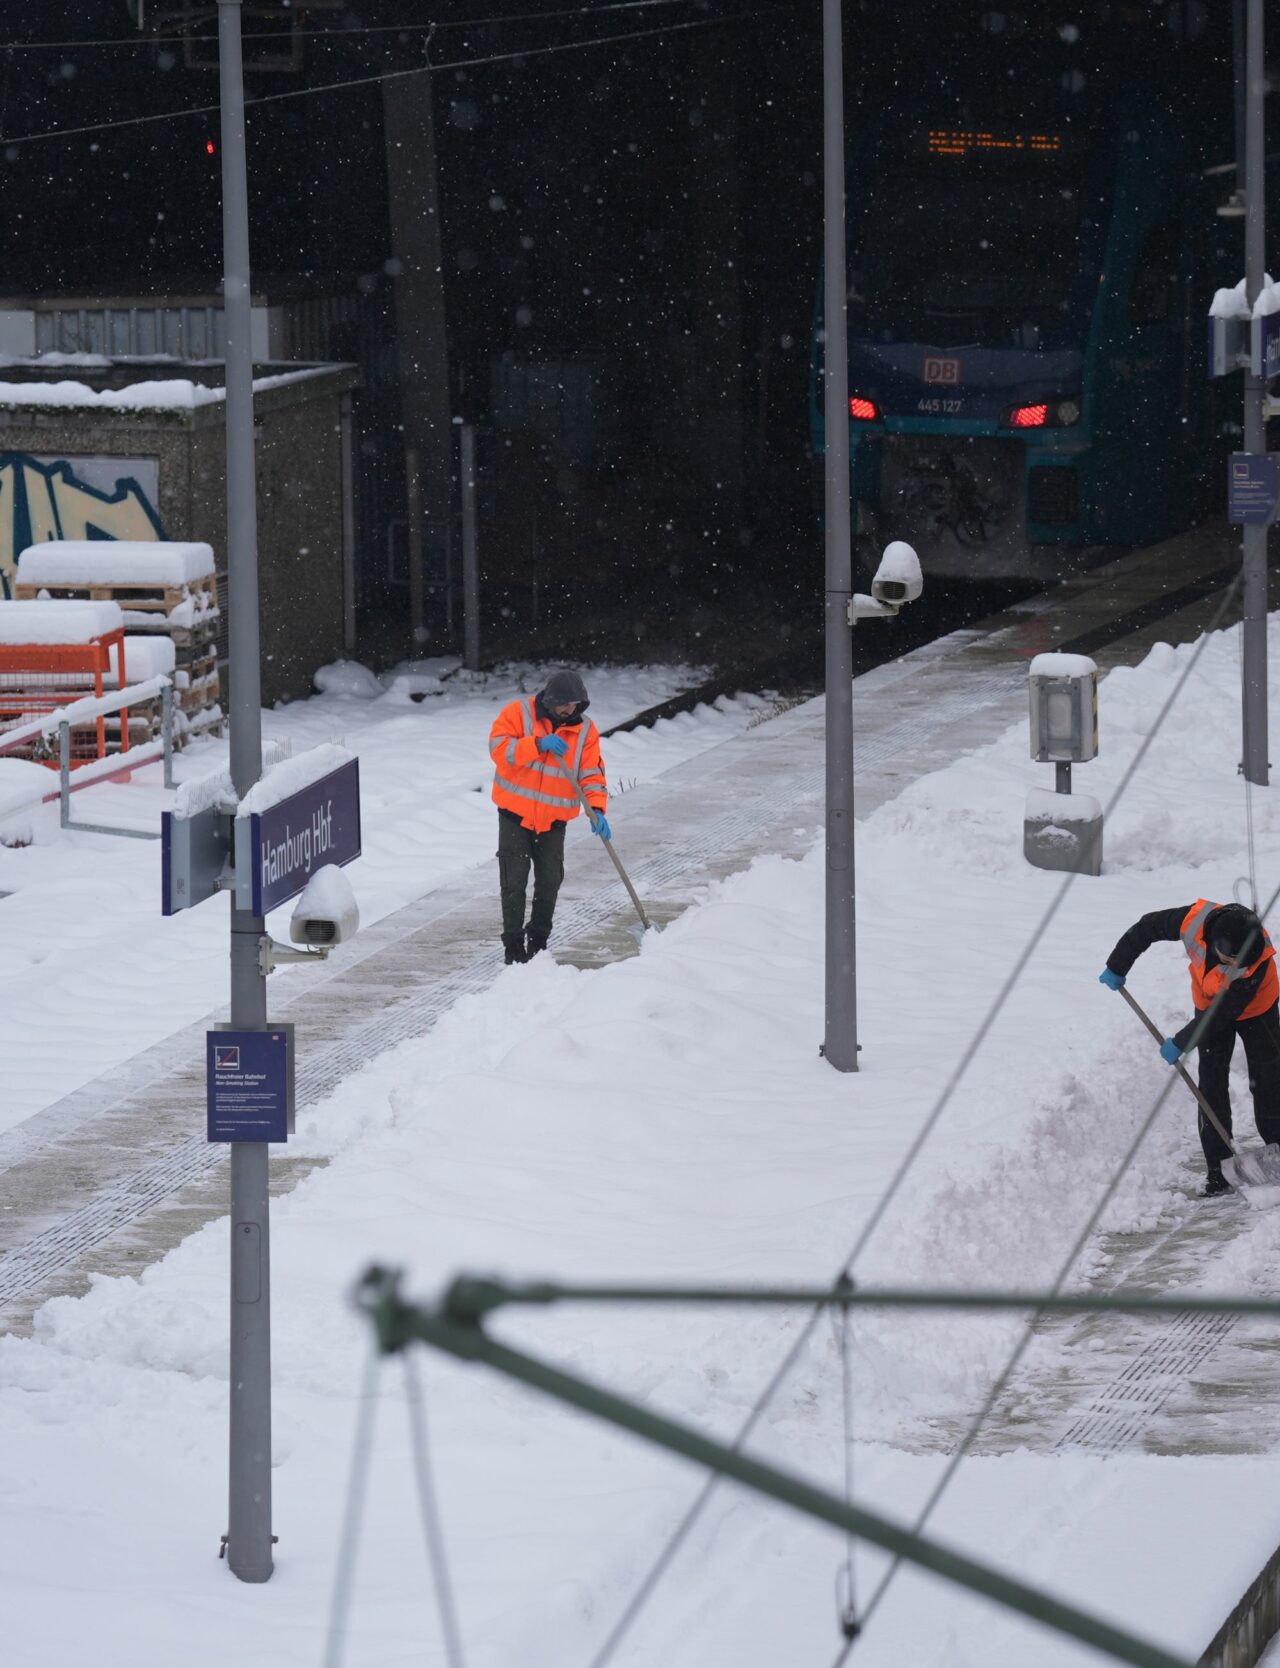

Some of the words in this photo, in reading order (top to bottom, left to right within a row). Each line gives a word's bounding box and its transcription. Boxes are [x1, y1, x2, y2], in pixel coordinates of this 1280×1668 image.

[926, 360, 957, 381] DB
[918, 399, 939, 412] 445
[942, 400, 961, 412] 127
[261, 825, 312, 889] Hamburg
[312, 800, 333, 858] Hbf
